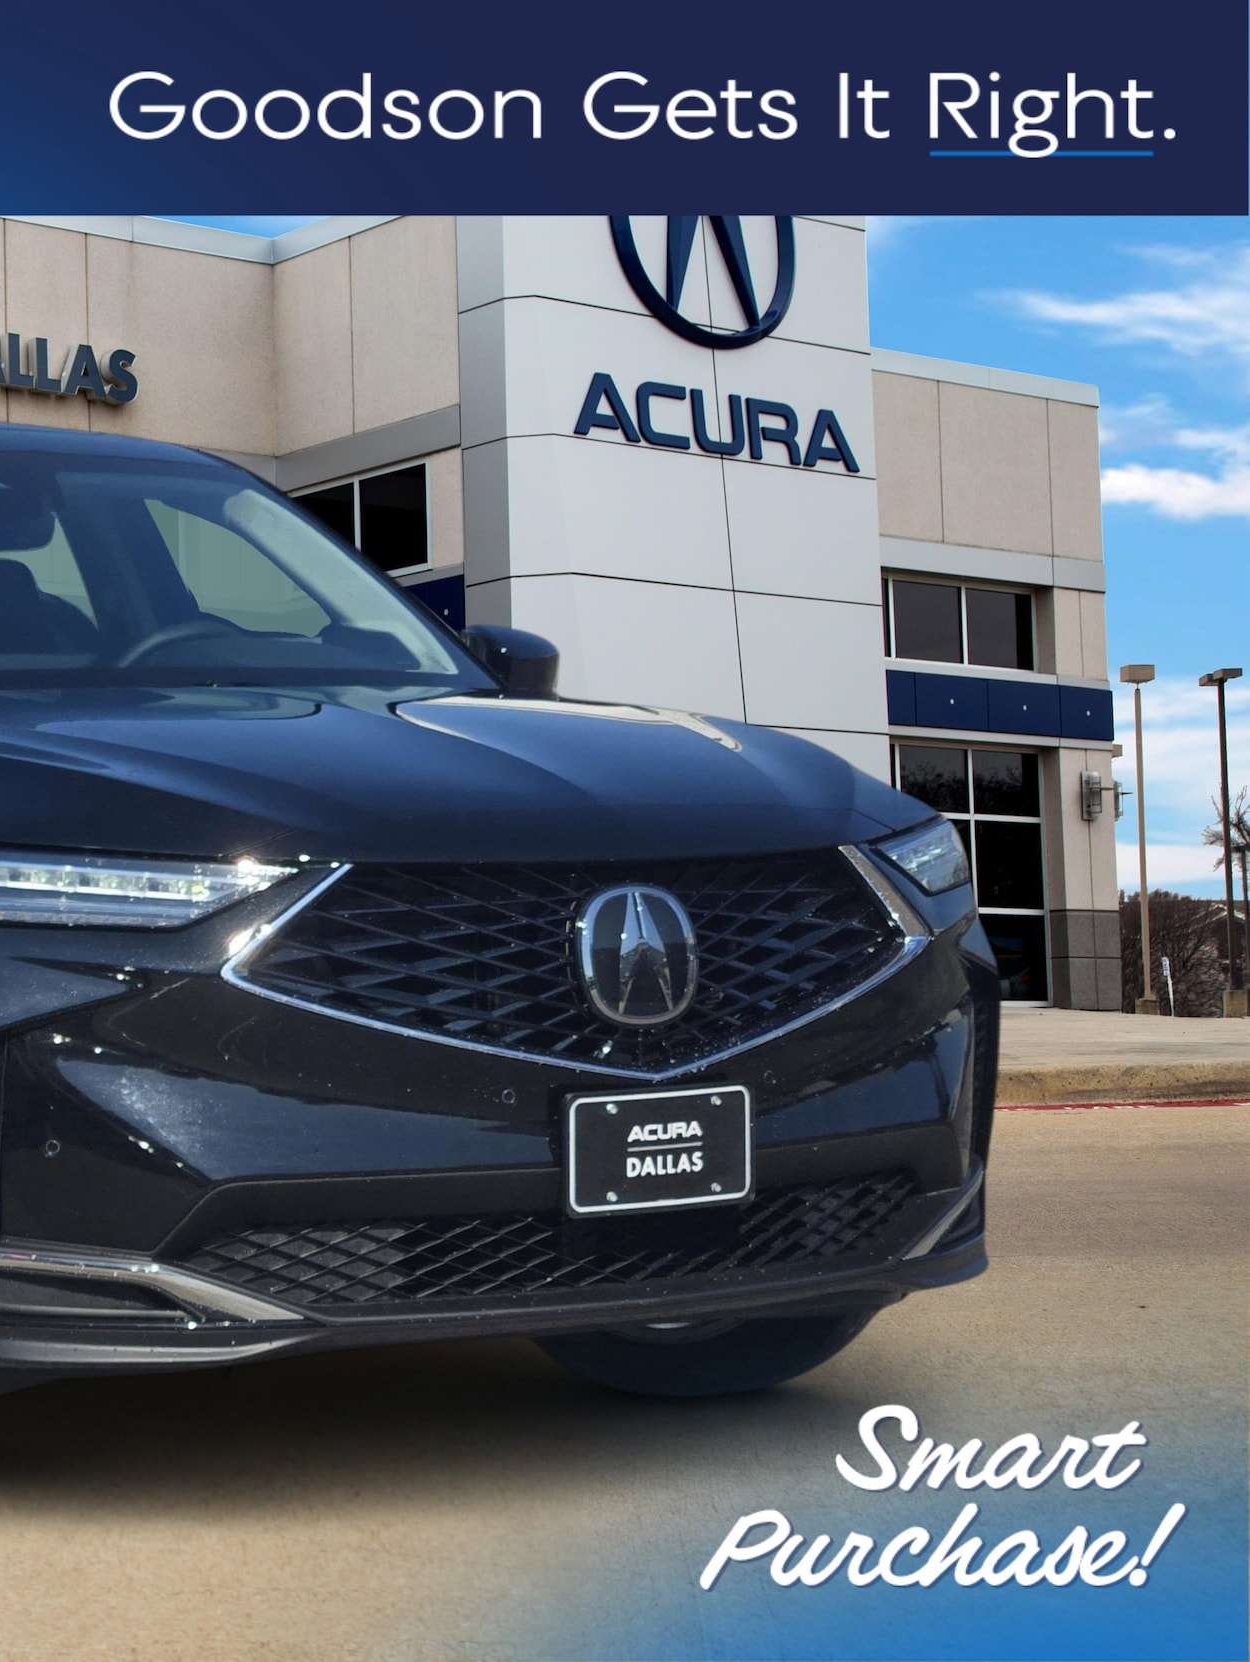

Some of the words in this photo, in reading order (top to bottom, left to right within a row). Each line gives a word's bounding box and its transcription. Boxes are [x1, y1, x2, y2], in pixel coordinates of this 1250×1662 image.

[573, 371, 861, 474] ACURA
[627, 1120, 703, 1143] ACURA
[626, 1151, 704, 1179] DALLAS
